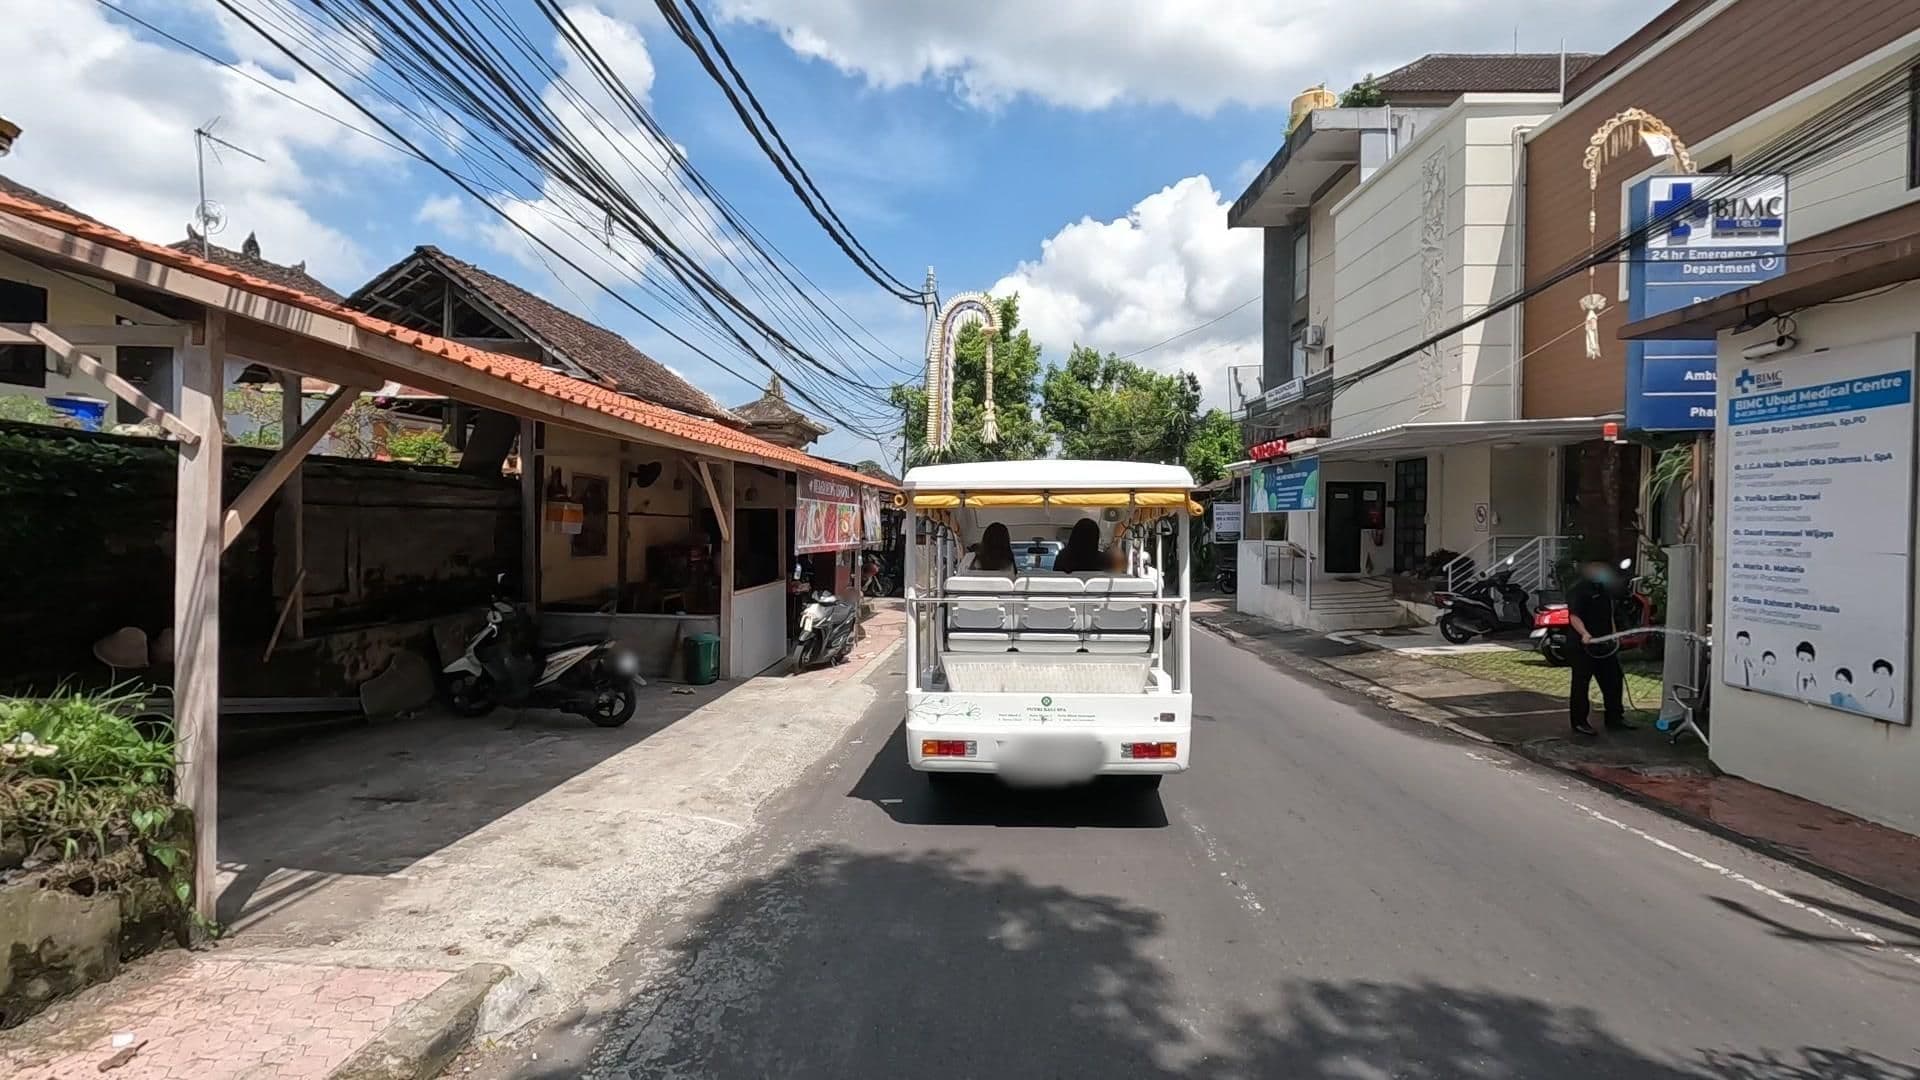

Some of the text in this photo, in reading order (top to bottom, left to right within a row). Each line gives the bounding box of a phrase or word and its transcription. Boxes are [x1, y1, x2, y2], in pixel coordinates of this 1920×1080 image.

[1715, 196, 1783, 217] BIMC
[1651, 250, 1758, 262] 24 hr Emergency
[1683, 264, 1757, 276] Department
[1756, 370, 1783, 384] BIMC
[1735, 398, 1765, 411] BIMC
[1766, 391, 1797, 407] Ubud
[1799, 383, 1850, 401] Medical
[1853, 377, 1903, 394] Centre
